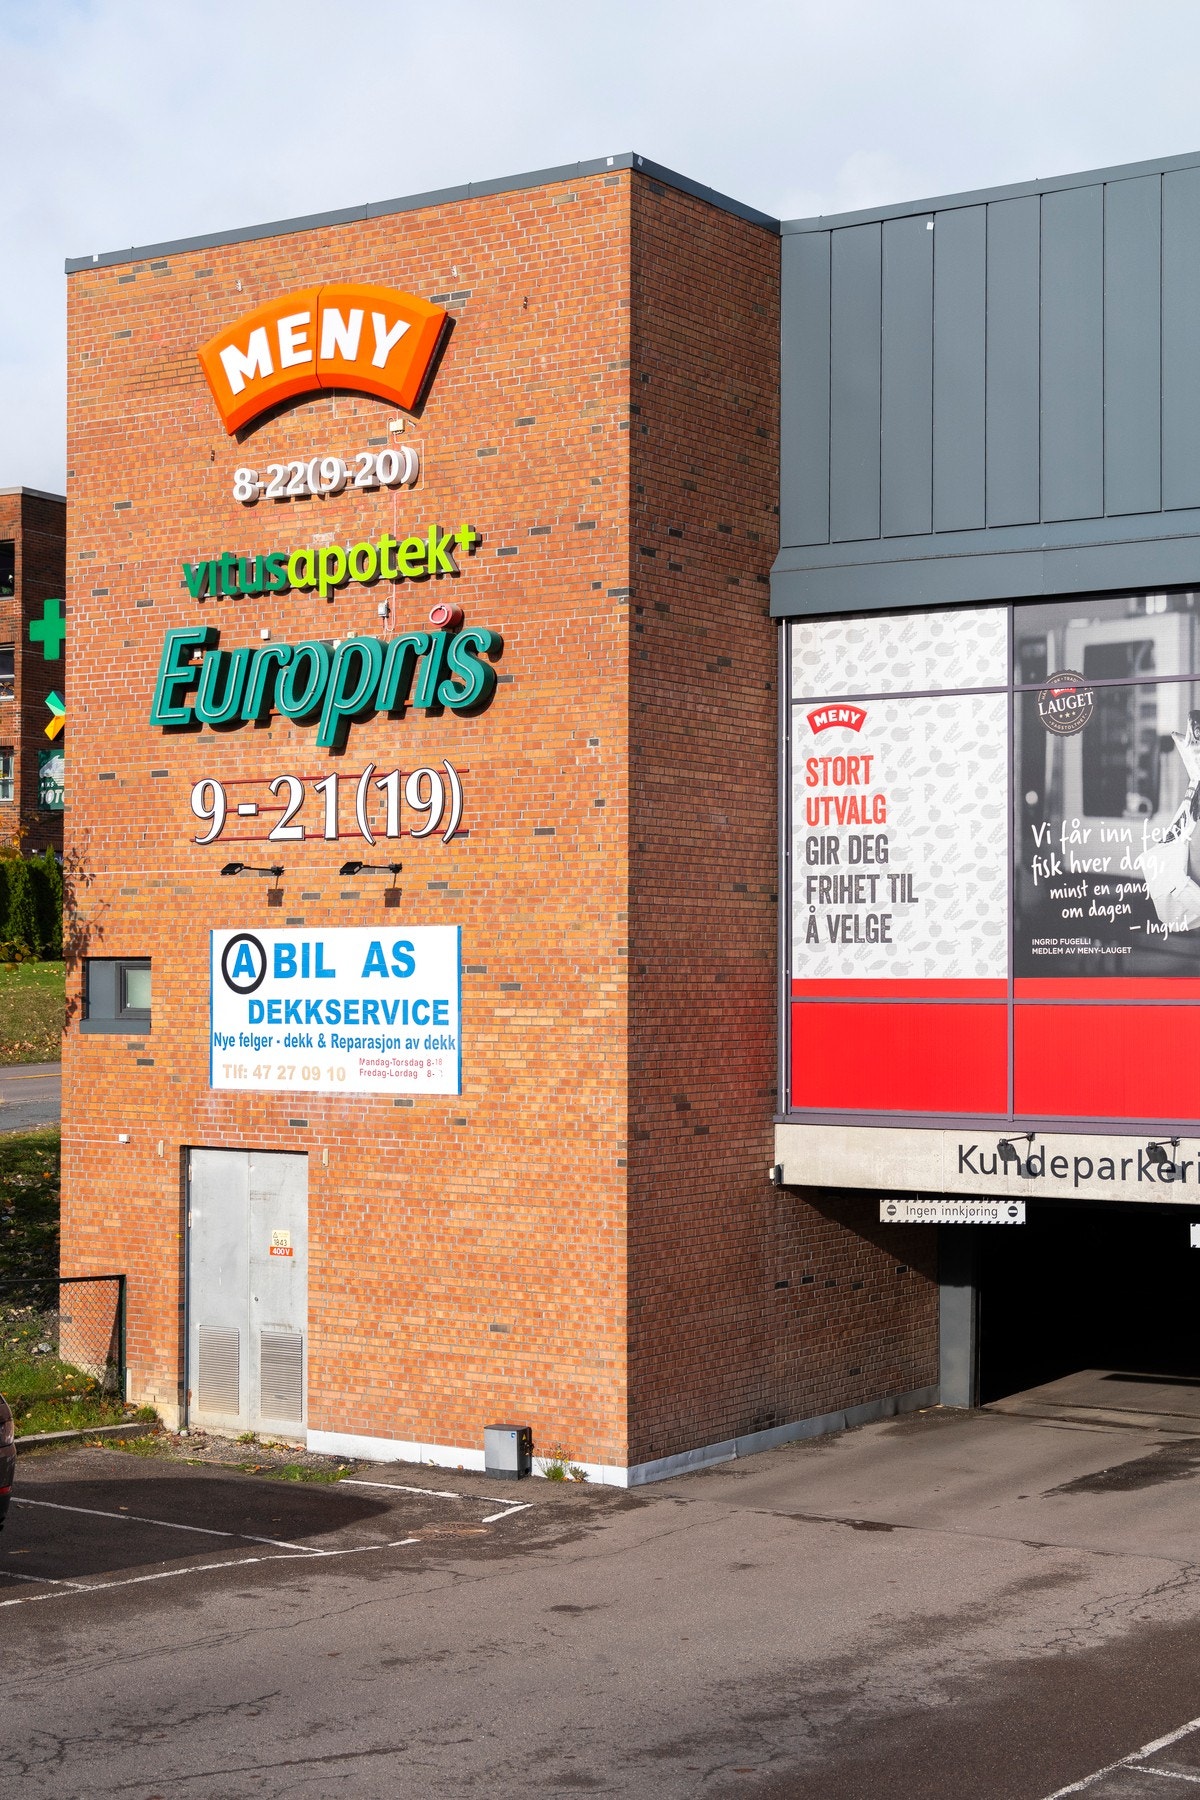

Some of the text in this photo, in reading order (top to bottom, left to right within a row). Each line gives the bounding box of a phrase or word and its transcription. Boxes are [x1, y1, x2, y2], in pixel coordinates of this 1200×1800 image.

[219, 308, 411, 396] MENY
[150, 603, 503, 747] Europris
[1038, 691, 1094, 716] LAUGET
[814, 709, 861, 728] MENY
[806, 755, 874, 787] STORT
[806, 794, 887, 826] UTVALG
[1031, 822, 1051, 848] Vi
[1060, 818, 1092, 854] får
[1100, 822, 1132, 843] inn
[805, 834, 889, 866] GIR DEG
[1031, 852, 1062, 886] fisk
[1070, 850, 1111, 874] hver
[806, 873, 919, 905] FRIHET TIL
[1050, 880, 1150, 901] minst en gang
[1061, 899, 1132, 923] om dagen
[805, 905, 893, 944] Å VELGE
[1146, 915, 1189, 941] Ingrid
[1031, 938, 1091, 946] INGRID FUGELLI
[1031, 947, 1132, 955] MEDLEM AV MENY-LAUGET
[274, 942, 336, 978] BIL
[361, 940, 416, 978] AS
[248, 999, 449, 1025] DEKKSERVICE
[214, 1032, 236, 1051] Nye
[239, 1032, 273, 1051] felger
[284, 1033, 313, 1048] dekk
[318, 1033, 326, 1048] &
[331, 1033, 401, 1053] Reparasjon
[405, 1038, 420, 1050] av
[424, 1034, 456, 1050] dekk
[223, 1064, 346, 1082] Tlf: 47 27 09 10
[359, 1058, 424, 1068] Mandag-Torsdag
[906, 1205, 998, 1219] Ingen innkjøring
